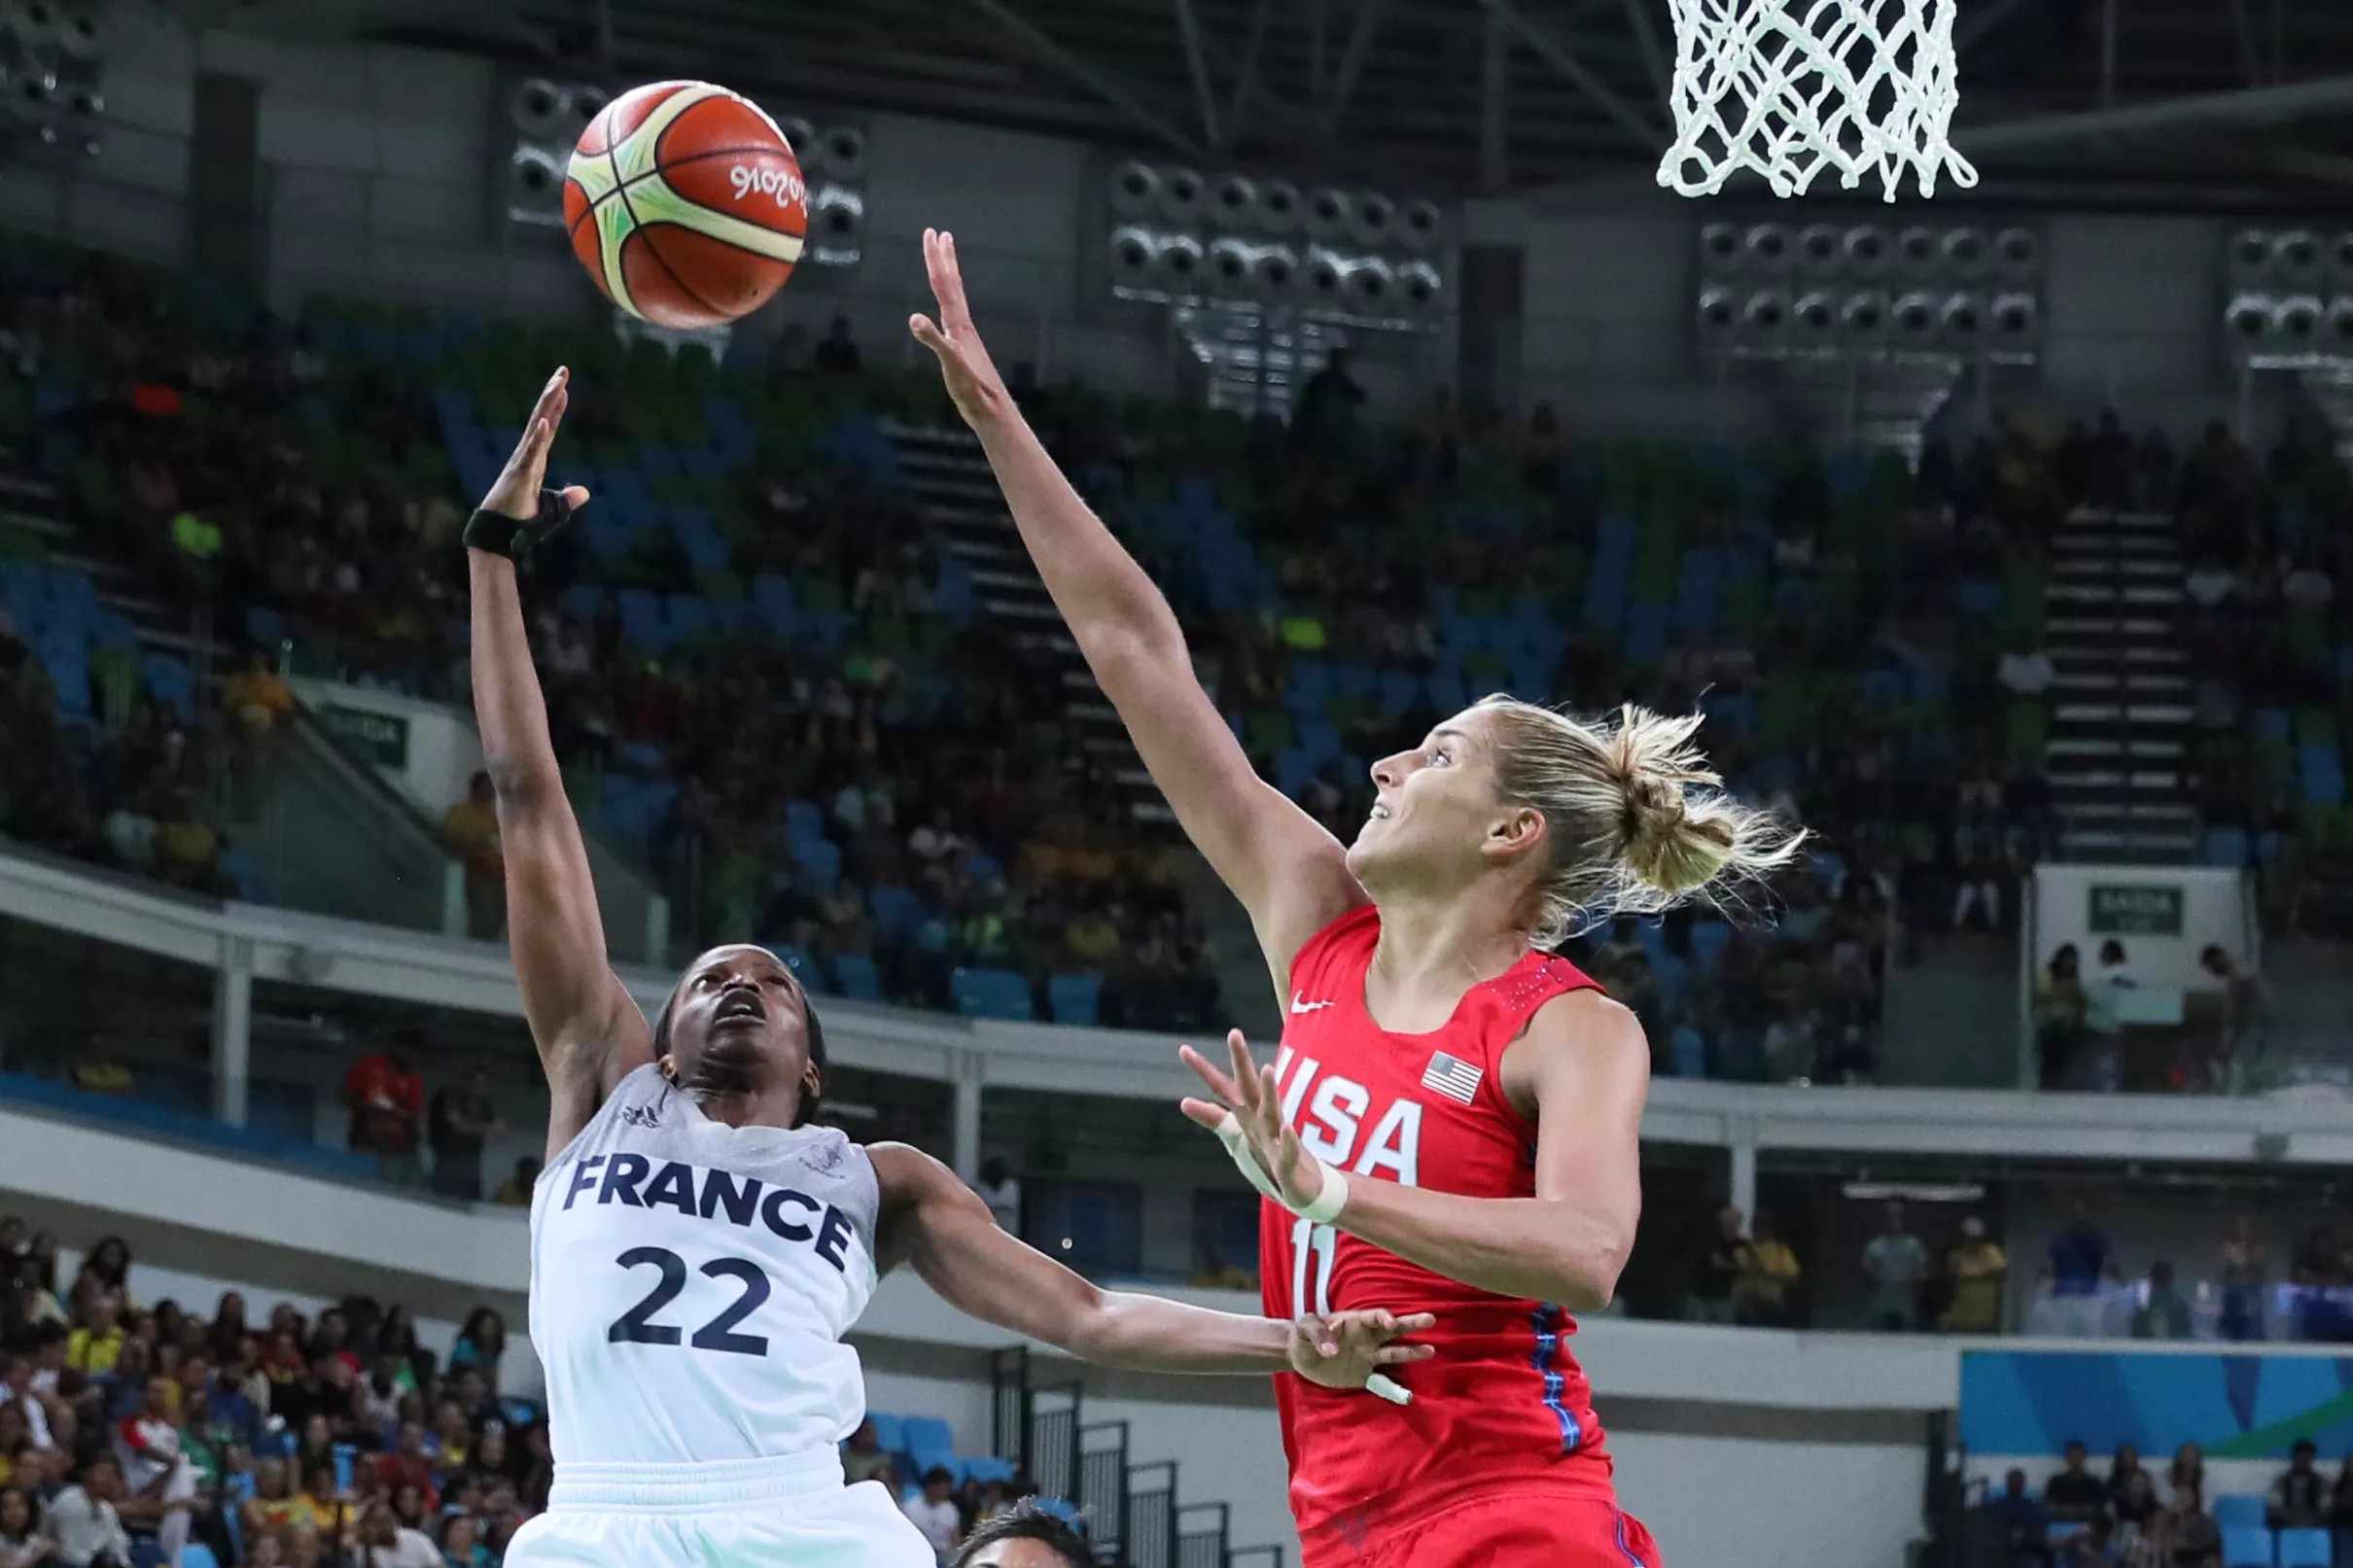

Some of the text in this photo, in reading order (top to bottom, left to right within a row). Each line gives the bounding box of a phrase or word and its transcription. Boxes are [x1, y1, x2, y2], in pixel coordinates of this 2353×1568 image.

[1275, 1045, 1423, 1187] USA
[563, 1153, 853, 1272] FRANCE
[1291, 1218, 1336, 1322] 11
[609, 1246, 771, 1357] 22
